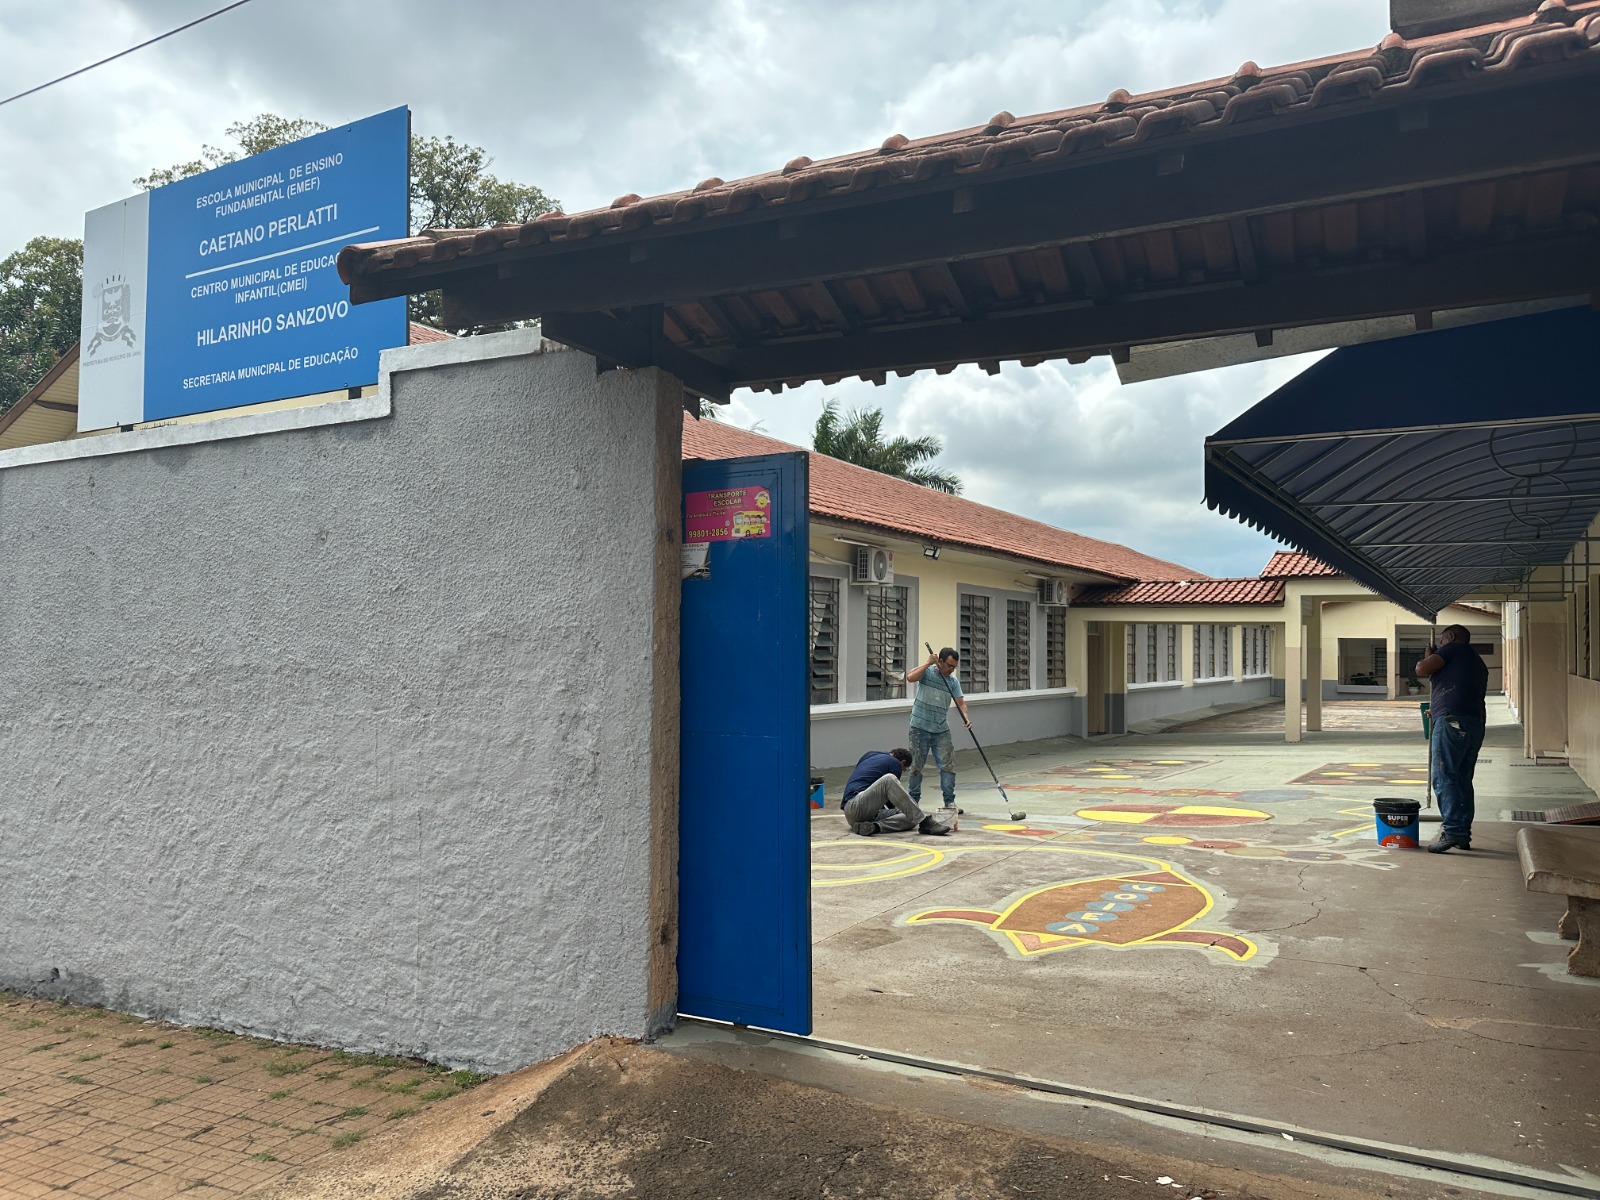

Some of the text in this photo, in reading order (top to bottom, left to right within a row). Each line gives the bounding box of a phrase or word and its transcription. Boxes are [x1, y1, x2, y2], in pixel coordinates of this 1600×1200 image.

[196, 152, 343, 209] ESCOLA MUNICIPAL DE ENSINO
[215, 176, 320, 218] FUNDAMENTAL (EMEF)
[199, 203, 338, 257] CAETANO PERLATTI
[191, 280, 228, 298] CENTRO
[231, 270, 282, 289] MUNICIPAL
[284, 263, 298, 277] DE
[235, 276, 308, 304] INFANTIL(CMEI)
[197, 300, 348, 346] HILARINHO SANZOVO
[183, 346, 358, 389] SECRETARIA MUNICIPAL DE EDUCAÇÃO
[708, 490, 747, 499] TRANSPORTE
